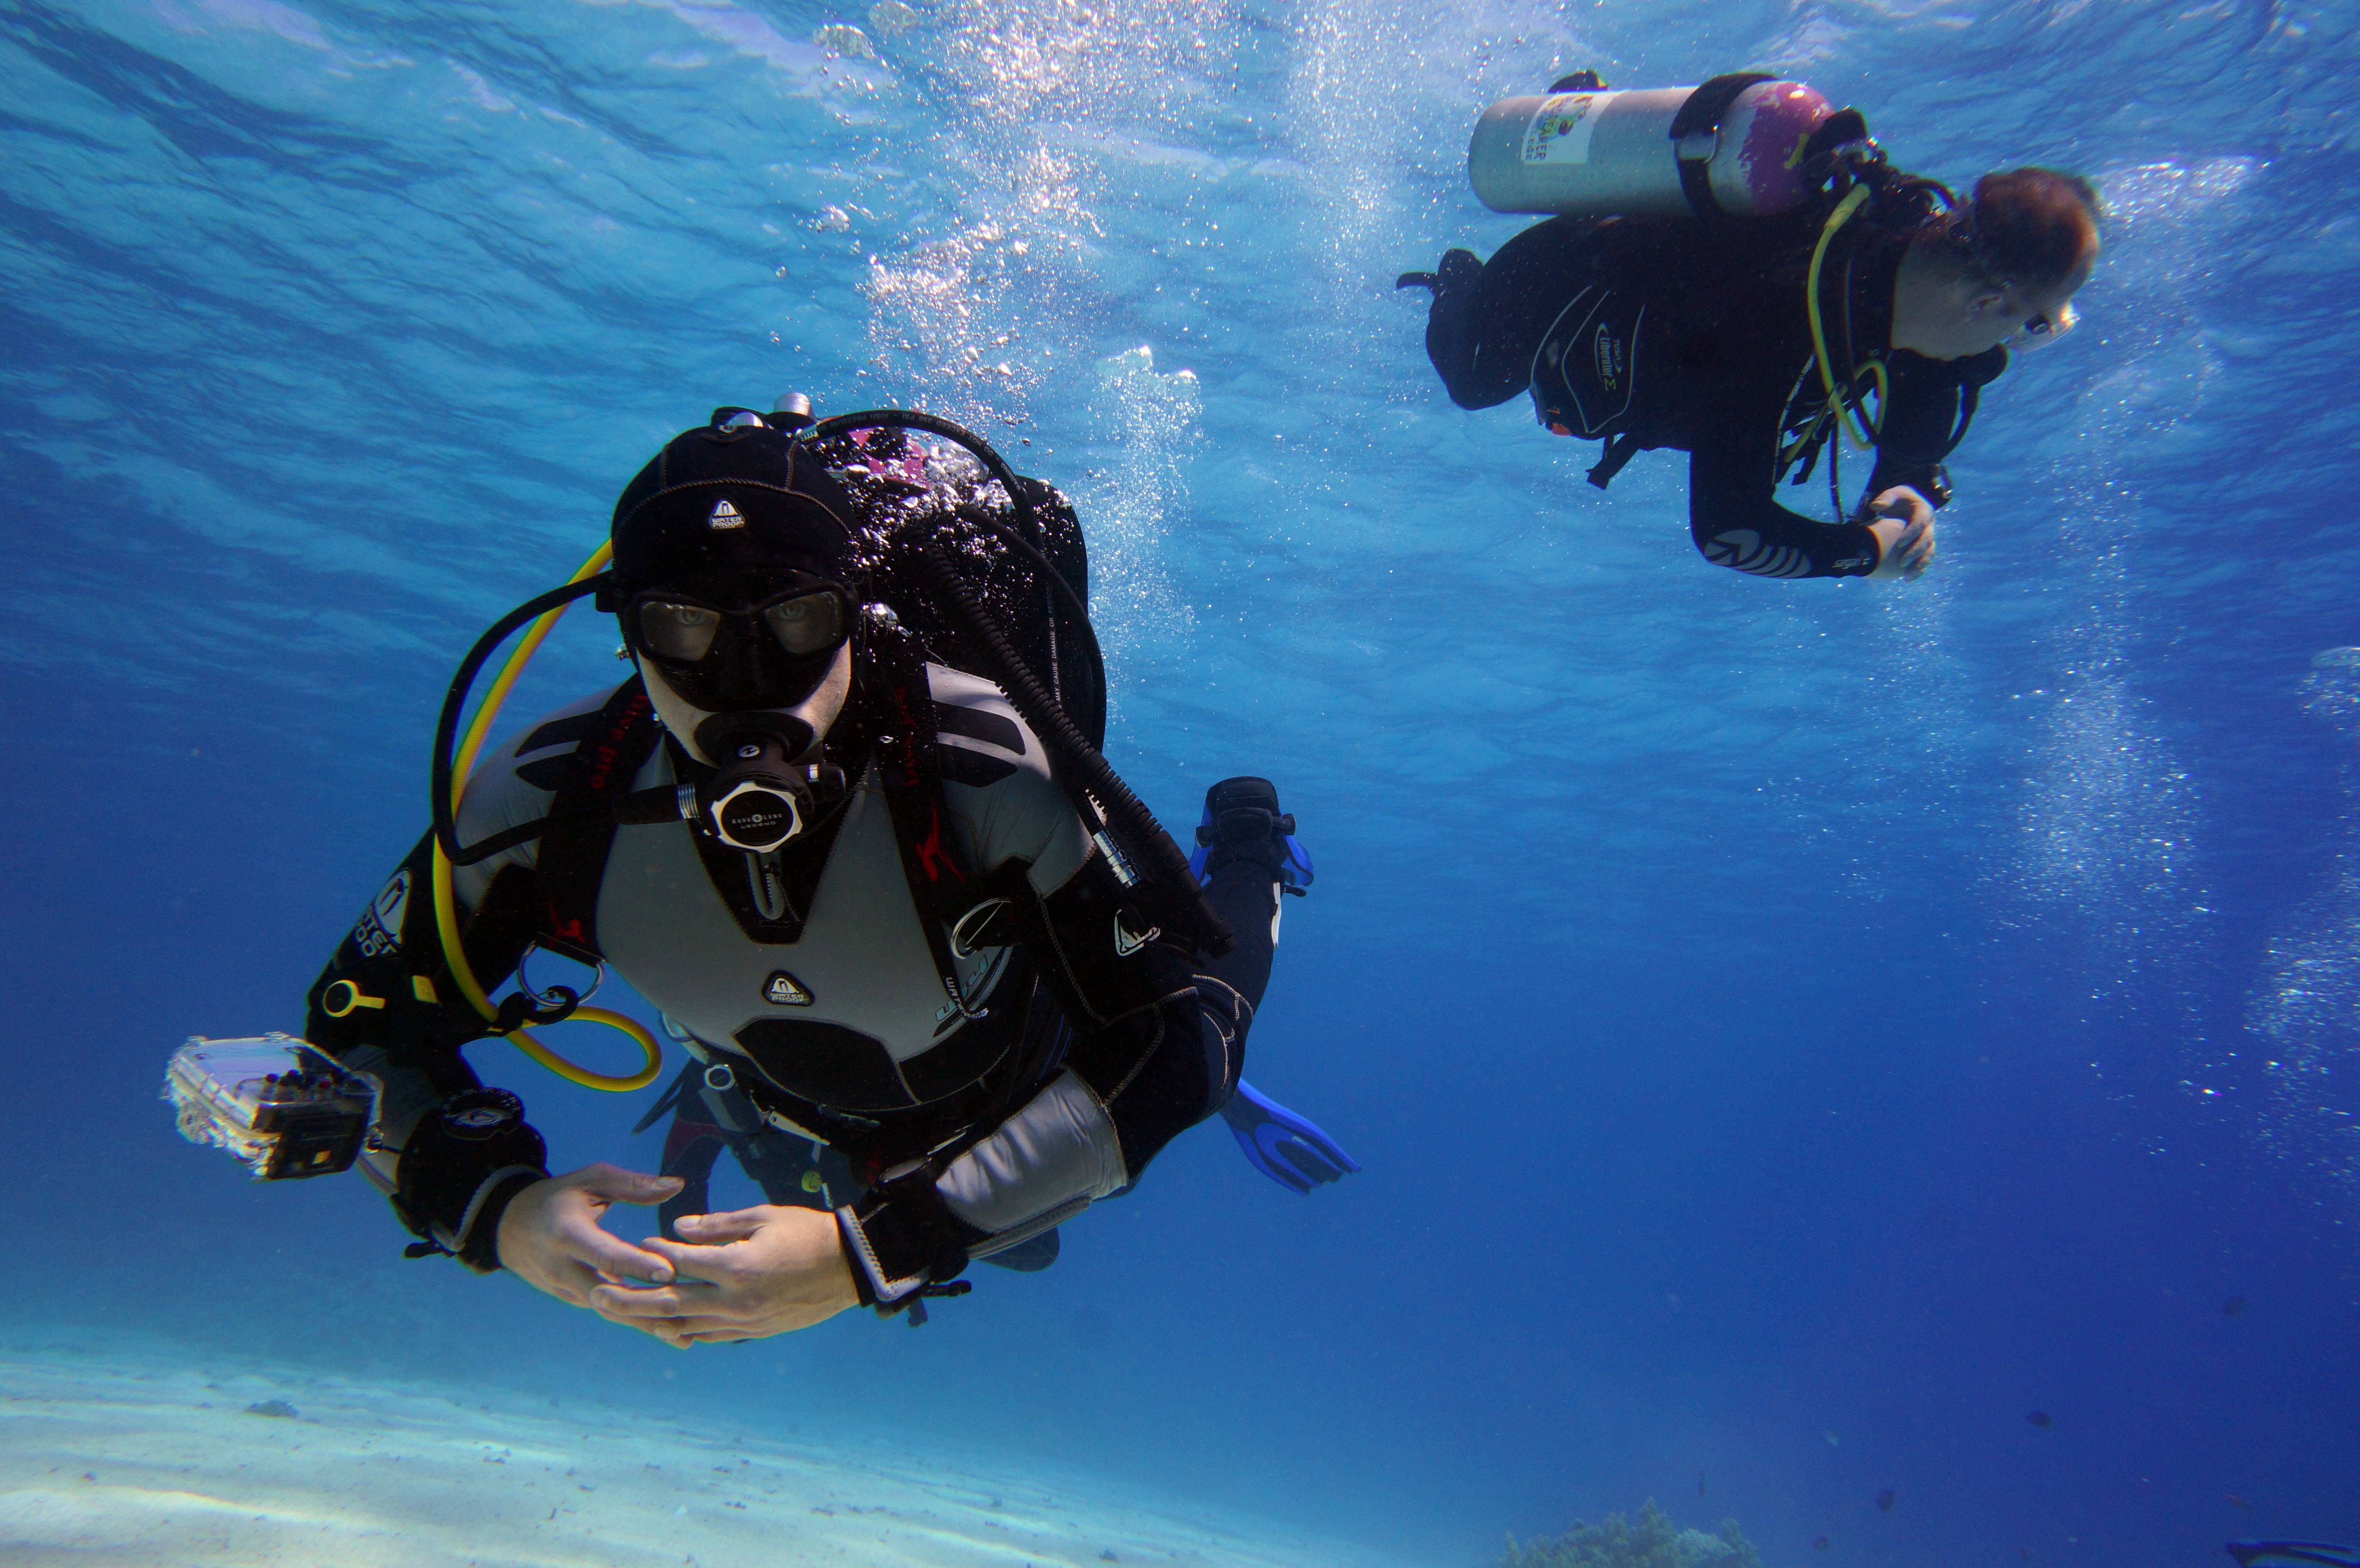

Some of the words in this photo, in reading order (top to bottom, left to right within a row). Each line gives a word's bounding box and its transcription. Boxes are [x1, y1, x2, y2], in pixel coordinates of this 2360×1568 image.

[1599, 337, 1614, 378] Liberator
[919, 416, 933, 424] 250
[936, 420, 965, 437] EXCEED
[967, 433, 982, 447] NOT
[983, 446, 994, 456] DO
[999, 462, 1021, 491] WARNING
[1048, 617, 1055, 627] OR
[740, 821, 777, 829] LEGEND
